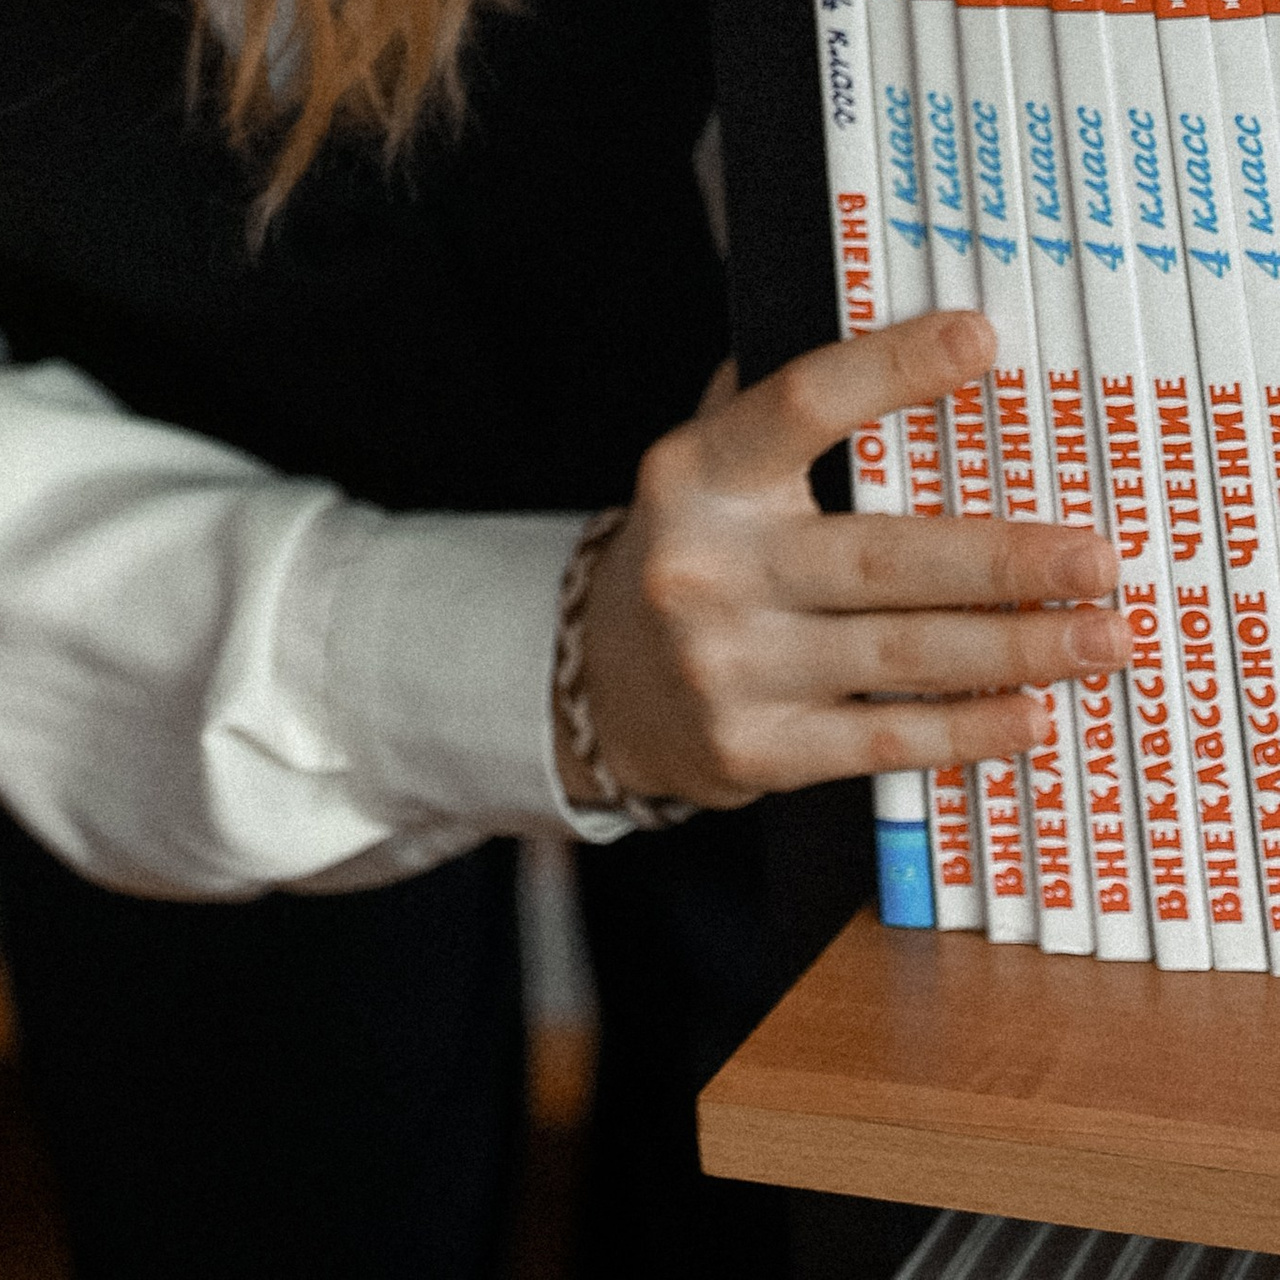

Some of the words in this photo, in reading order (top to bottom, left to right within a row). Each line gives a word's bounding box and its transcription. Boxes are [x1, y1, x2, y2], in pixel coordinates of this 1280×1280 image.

[828, 29, 857, 131] класс
[884, 85, 919, 208] класс
[926, 90, 964, 214] класс
[971, 99, 1008, 224] класс
[1024, 100, 1062, 224] класс
[1075, 104, 1115, 230] класс
[1126, 106, 1167, 232] класс
[1178, 111, 1221, 237] класс
[1233, 112, 1276, 238] класс
[888, 217, 928, 251] 4
[933, 223, 975, 257] 4
[979, 233, 1020, 267] 4
[1031, 234, 1074, 269] 4
[1083, 239, 1127, 274] 4
[1135, 242, 1180, 276] 4
[1188, 247, 1233, 282] 4
[1243, 248, 1280, 283] 4
[1102, 375, 1150, 560] ЧТЕНИЕ
[1155, 376, 1203, 562] ЧТЕНИЕ
[1209, 381, 1260, 569] ЧТЕНИЕ
